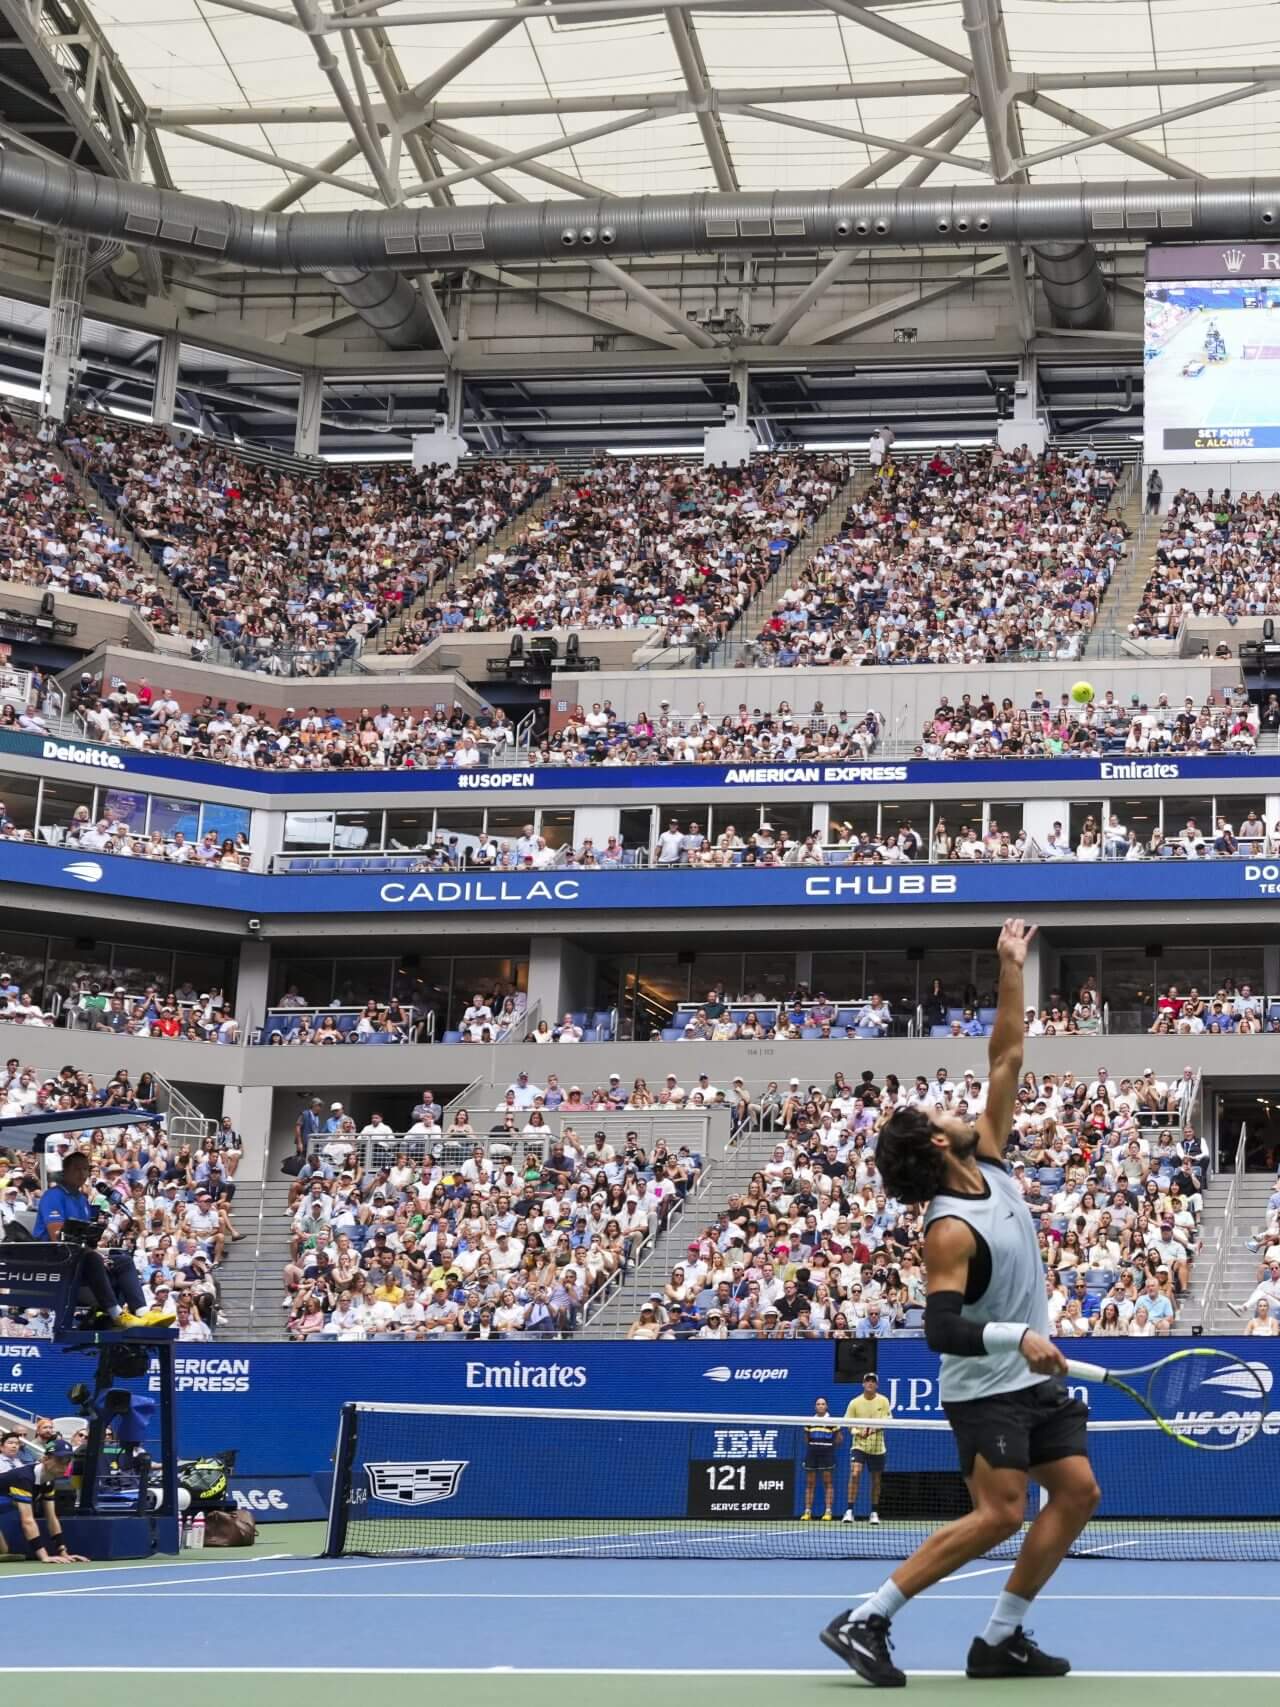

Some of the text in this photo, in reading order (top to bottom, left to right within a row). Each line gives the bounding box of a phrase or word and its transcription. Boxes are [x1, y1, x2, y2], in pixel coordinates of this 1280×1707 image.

[1198, 428, 1251, 438] SET POINT
[1206, 438, 1254, 447] ALCARAZ
[43, 741, 125, 769] Deloitte.
[725, 766, 907, 783] AMERICAN EXPRESS
[1100, 761, 1179, 779] Emirates
[458, 773, 534, 788] #USOPEN
[380, 880, 580, 903] CADILLAC
[805, 875, 957, 895] CHUBB
[0, 1344, 41, 1358] USTA
[11, 1363, 22, 1377] 6
[466, 1360, 587, 1388] Emirates
[734, 1368, 789, 1382] us open
[148, 1376, 250, 1392] EPRESS
[713, 1430, 779, 1458] IBM
[706, 1465, 784, 1491] 121 MPH
[710, 1502, 770, 1511] SERVE SPEED
